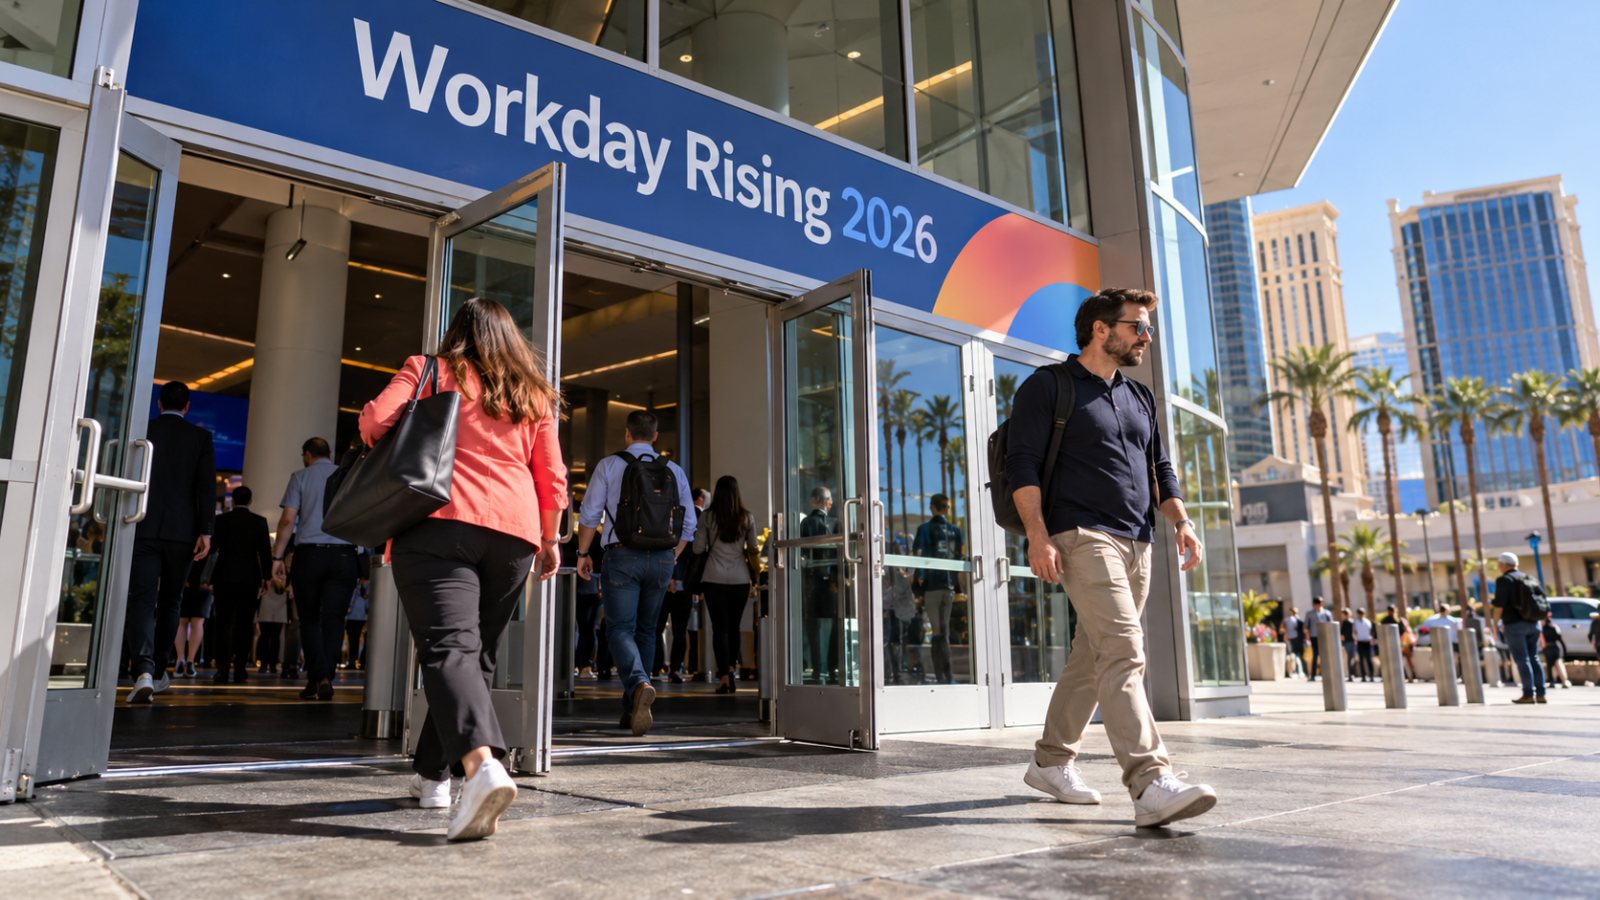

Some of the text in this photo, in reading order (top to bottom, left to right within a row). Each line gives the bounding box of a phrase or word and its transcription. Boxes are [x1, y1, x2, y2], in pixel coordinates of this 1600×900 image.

[354, 18, 938, 263] Workday Rising 2026
